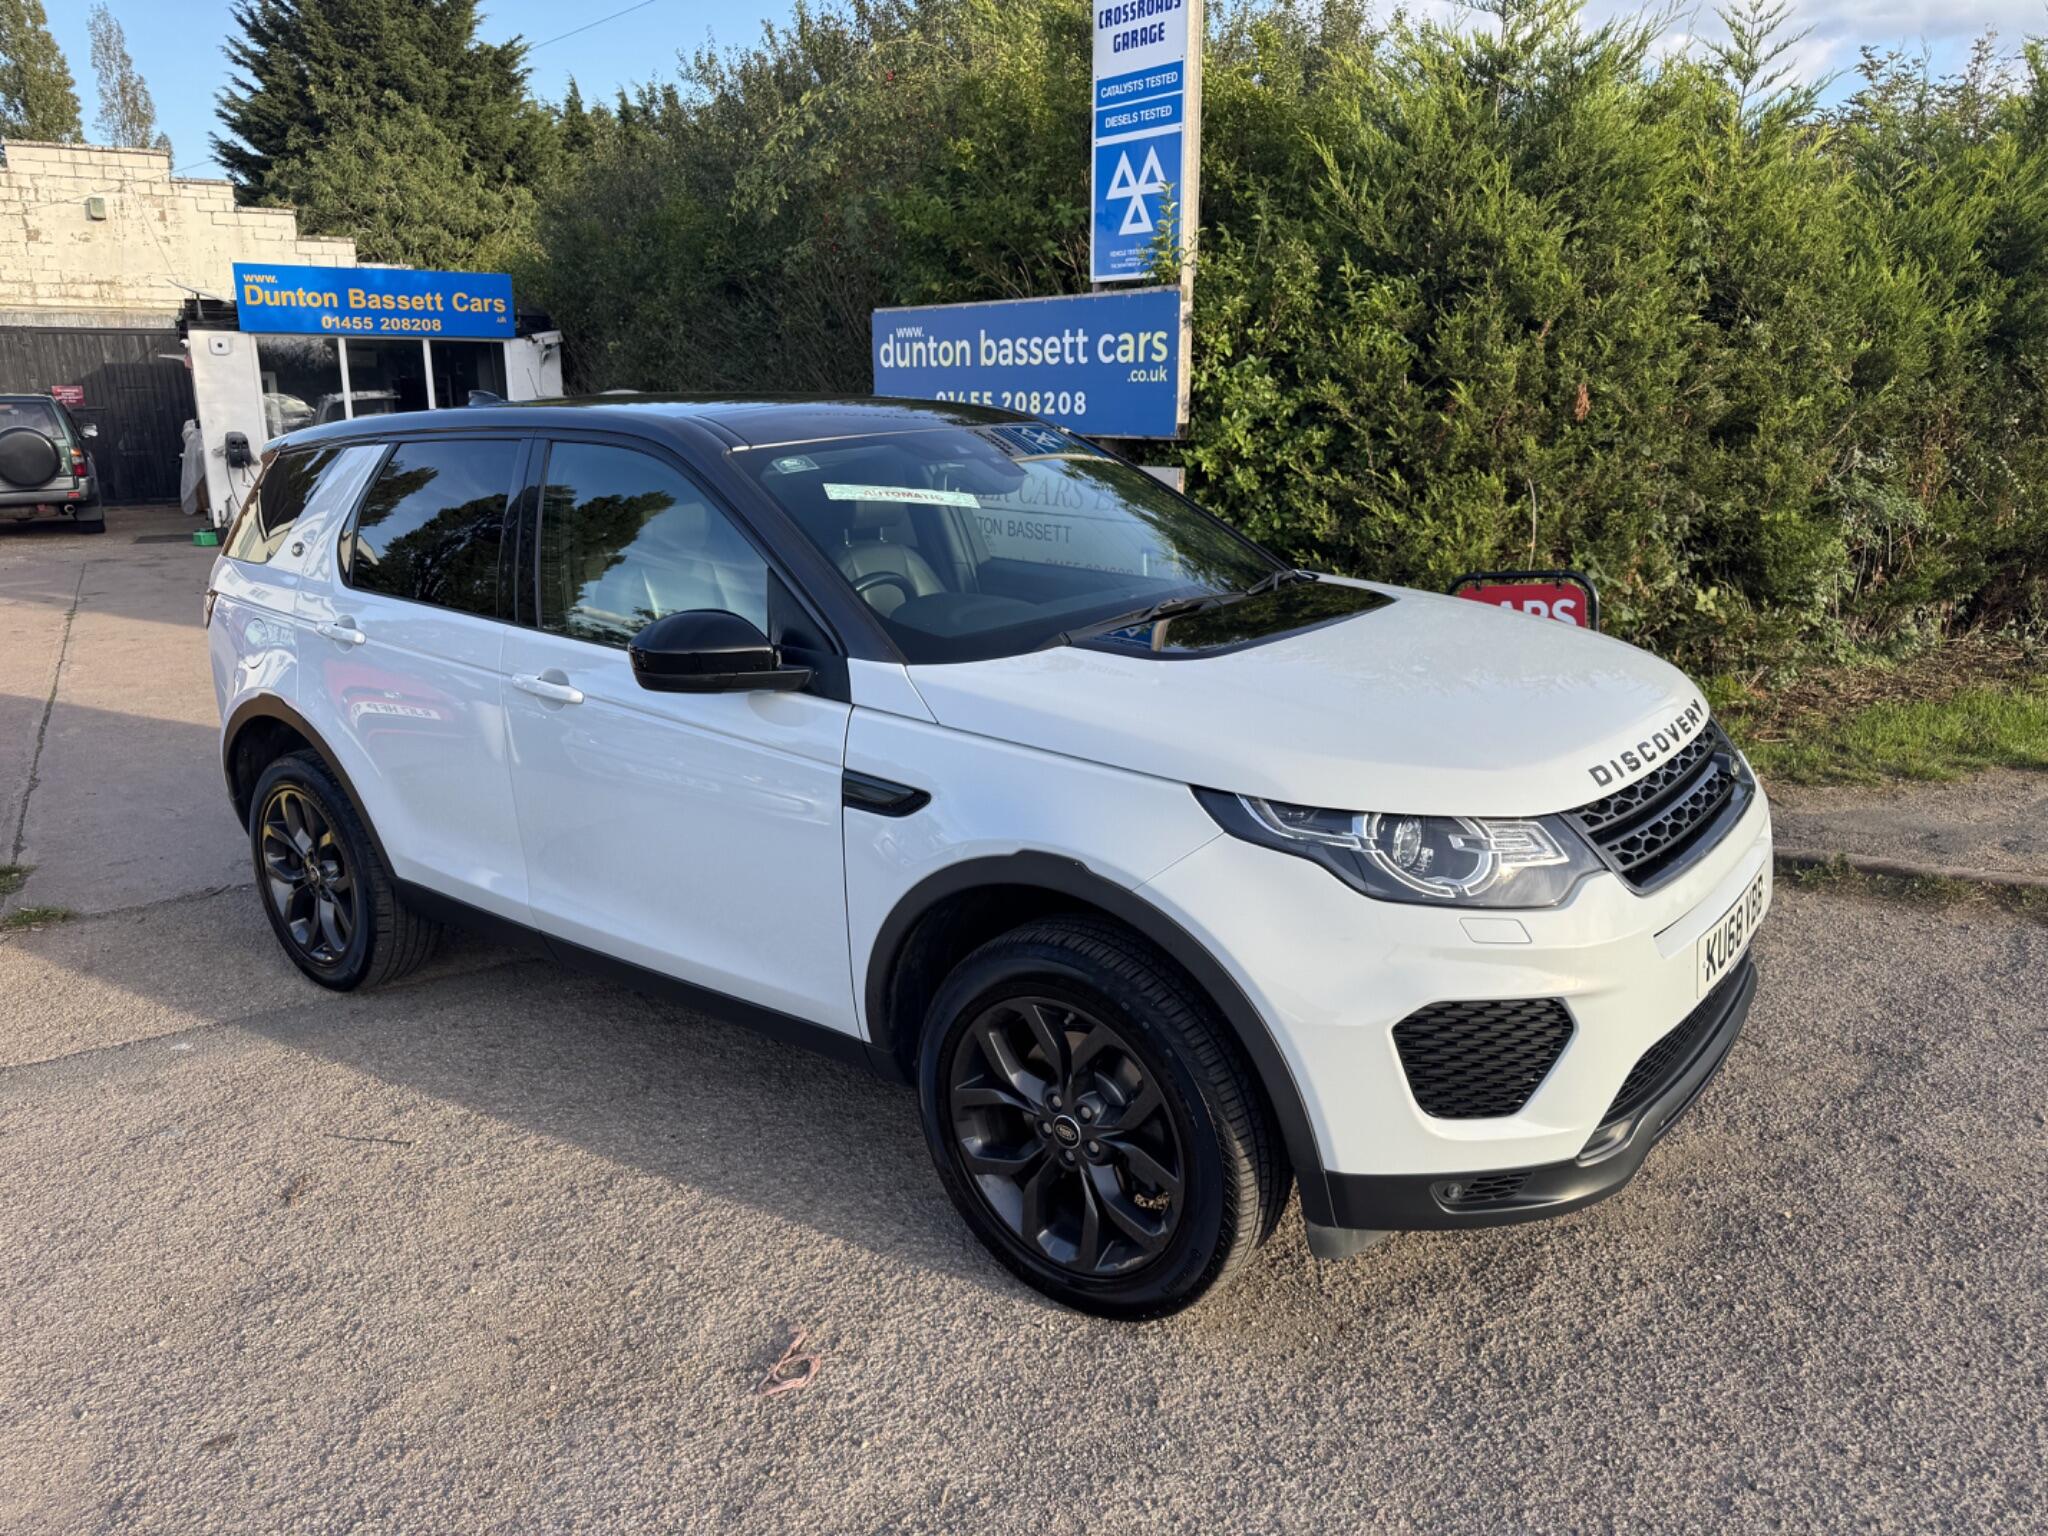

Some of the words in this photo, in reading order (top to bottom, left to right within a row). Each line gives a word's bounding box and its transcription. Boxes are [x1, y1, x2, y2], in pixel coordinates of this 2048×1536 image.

[1113, 21, 1165, 53] GARAGE
[1101, 79, 1144, 98] CATALYSTS
[1145, 71, 1178, 89] TESTED
[1140, 105, 1172, 121] TESTED
[244, 284, 338, 308] Dunton
[348, 288, 444, 312] Bassett
[452, 292, 506, 313] Cars
[321, 315, 373, 330] 01455
[380, 317, 442, 332] 208208
[896, 326, 924, 338] www.
[879, 334, 972, 368] dunton
[980, 328, 1088, 366] bassett
[1098, 330, 1169, 364] cars
[1127, 366, 1168, 382] .co.uk
[1002, 391, 1086, 415] 208208
[864, 489, 944, 501] AUTOMATIC
[1019, 475, 1084, 509] CARS
[1008, 520, 1072, 544] BASSETT
[1588, 698, 1704, 787] DISCOVERY
[1706, 904, 1743, 982] KU68
